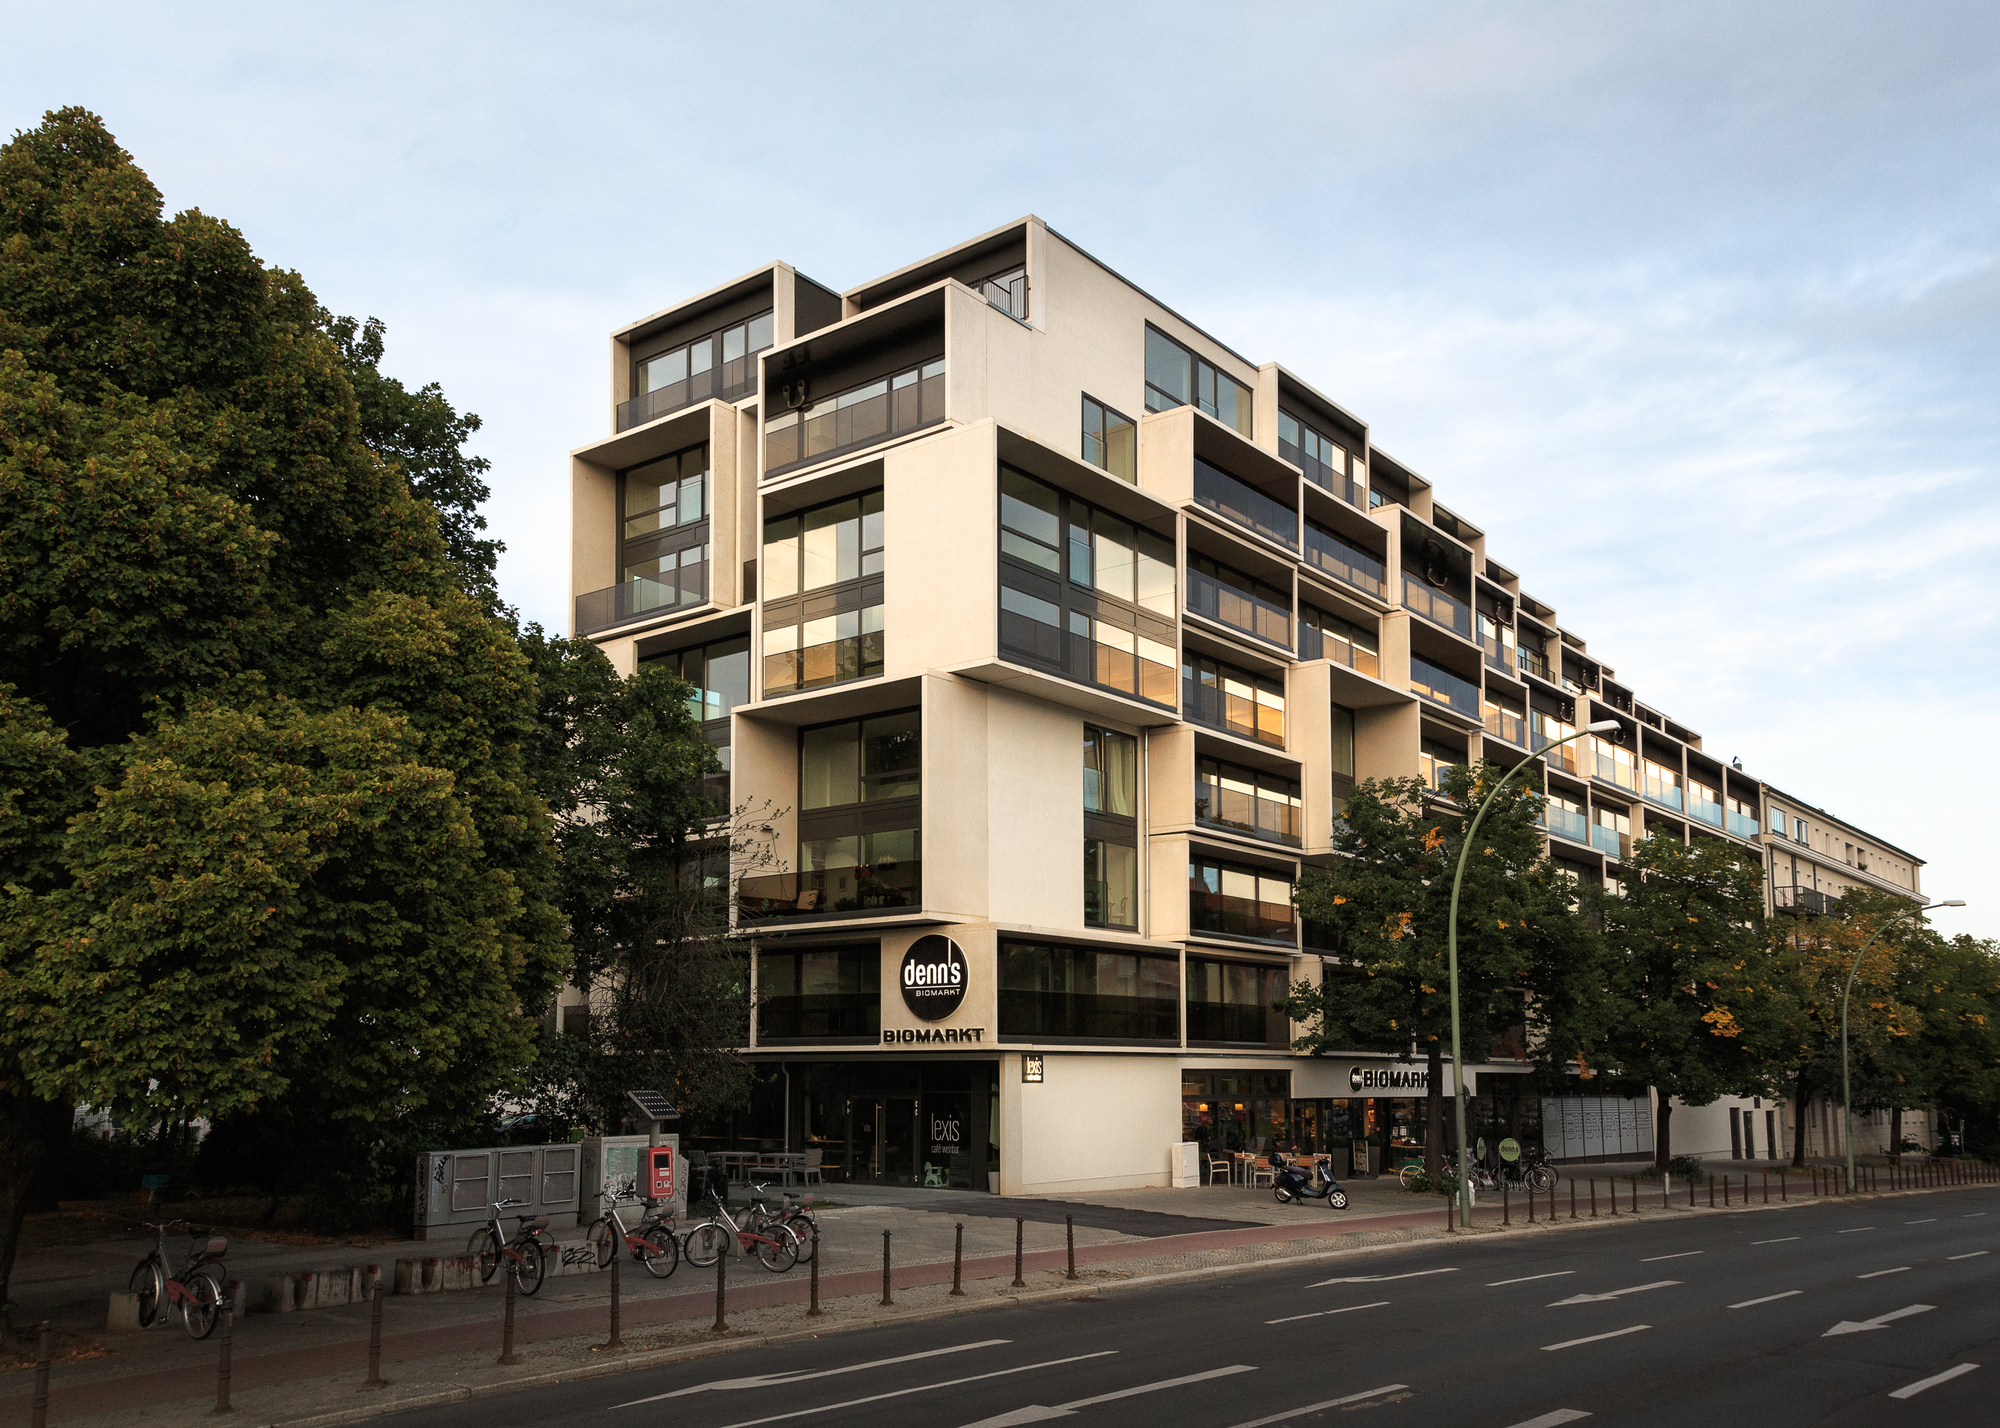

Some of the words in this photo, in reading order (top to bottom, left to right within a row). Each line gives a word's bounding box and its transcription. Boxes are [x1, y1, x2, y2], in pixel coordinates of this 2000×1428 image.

[904, 938, 961, 986] denn's
[915, 988, 961, 997] BIOMARKT
[883, 1028, 985, 1043] BIOMARKT
[1026, 1056, 1042, 1074] lexis
[1363, 1070, 1429, 1088] BIOMARK
[931, 1112, 960, 1142] lexis
[931, 1143, 941, 1154] café
